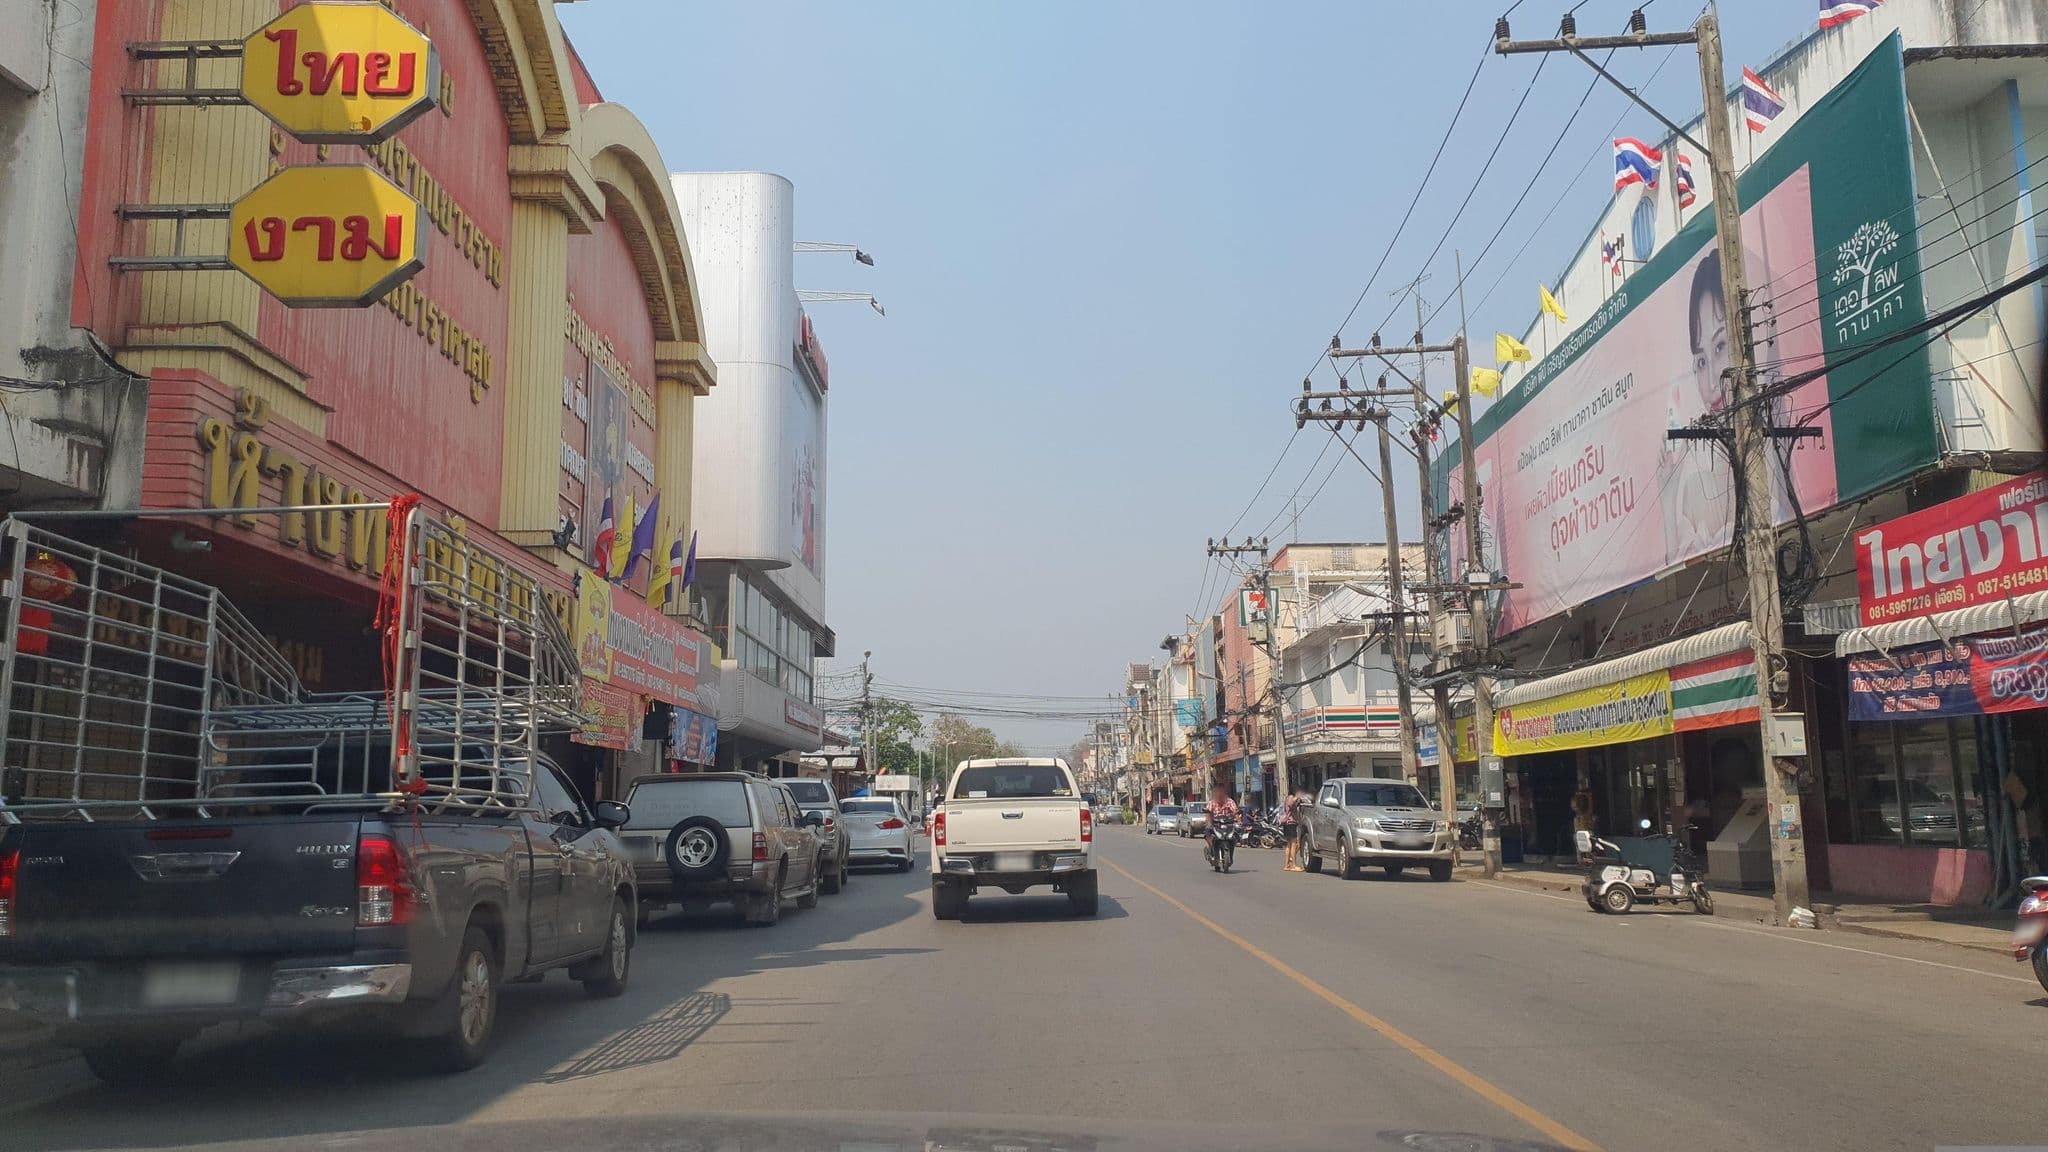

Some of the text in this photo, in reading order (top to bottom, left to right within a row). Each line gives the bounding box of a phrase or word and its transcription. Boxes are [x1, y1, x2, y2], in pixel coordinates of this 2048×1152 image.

[265, 28, 417, 98] ไทย
[244, 213, 403, 262] งาม
[1834, 261, 1899, 318] เดอ ลีฟ
[1838, 295, 1904, 344] ทานาคา
[1869, 593, 1932, 620] 081-5967276
